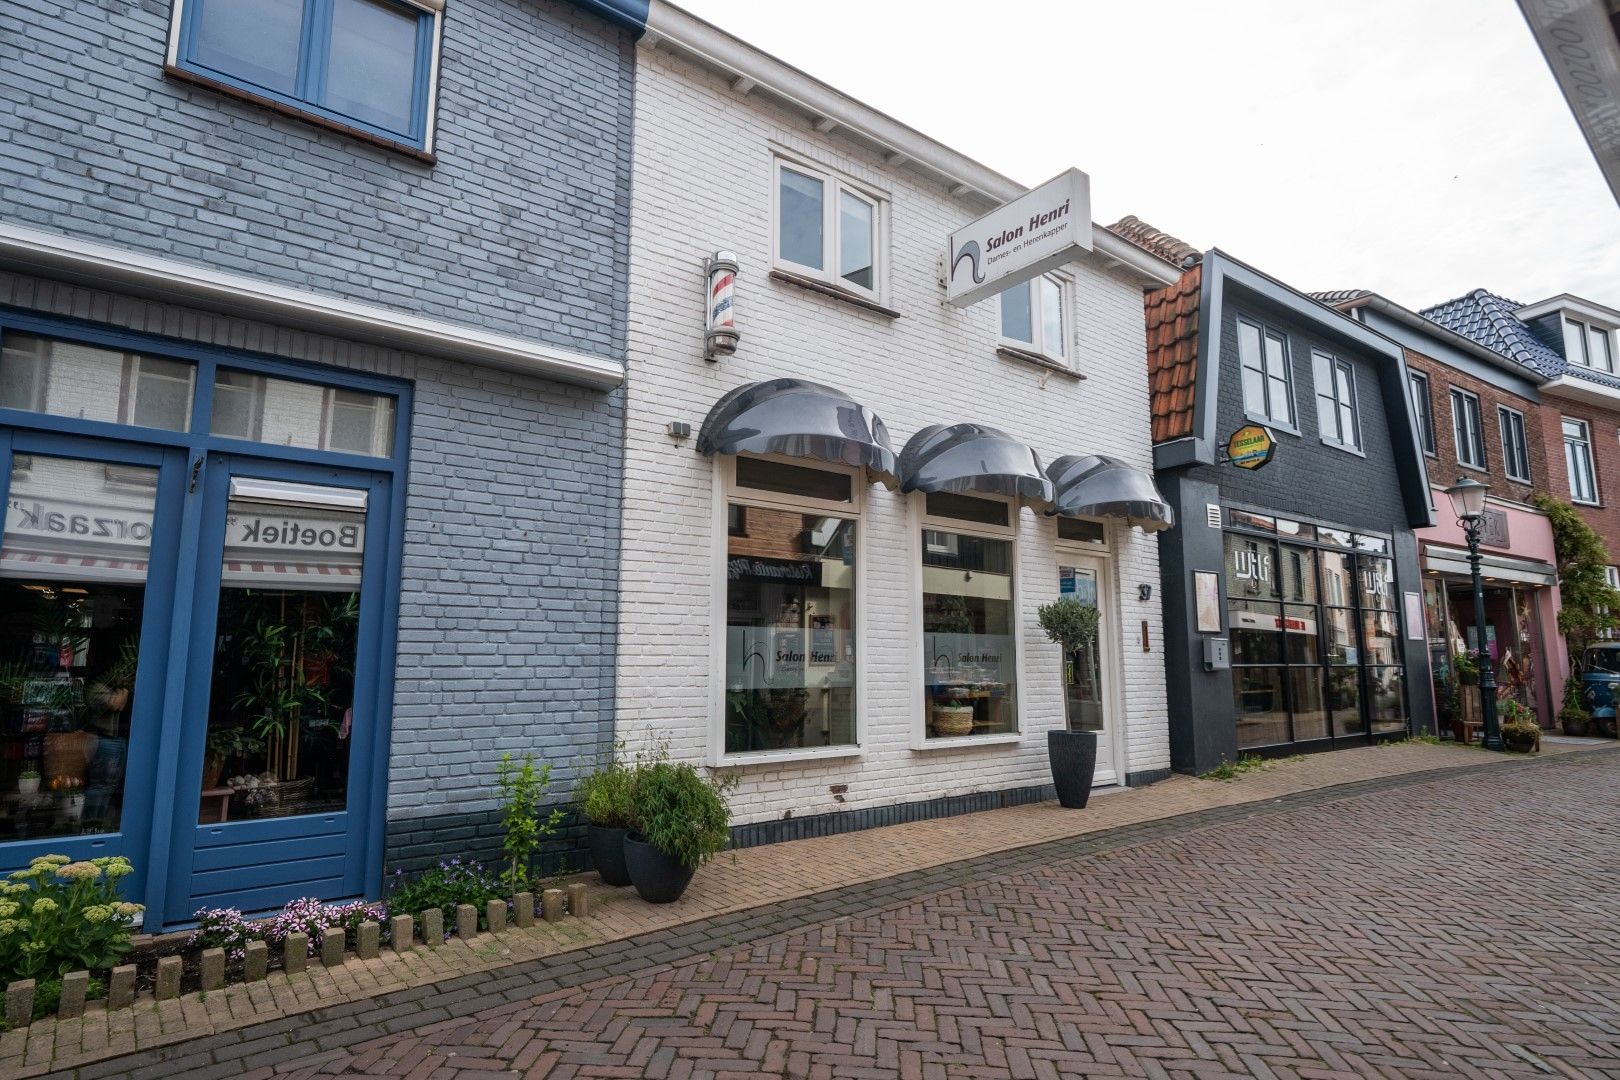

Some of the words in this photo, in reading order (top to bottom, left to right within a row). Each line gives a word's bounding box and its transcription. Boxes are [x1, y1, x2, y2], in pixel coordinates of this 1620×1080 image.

[986, 225, 1024, 252] Salon
[1029, 198, 1070, 232] Henri
[987, 249, 1012, 265] Dames-
[1012, 244, 1022, 253] en
[1023, 222, 1068, 248] Herenkapper
[775, 650, 806, 662] Salon
[809, 650, 838, 663] Henr
[957, 652, 980, 663] Salon
[981, 652, 1003, 663] Henri
